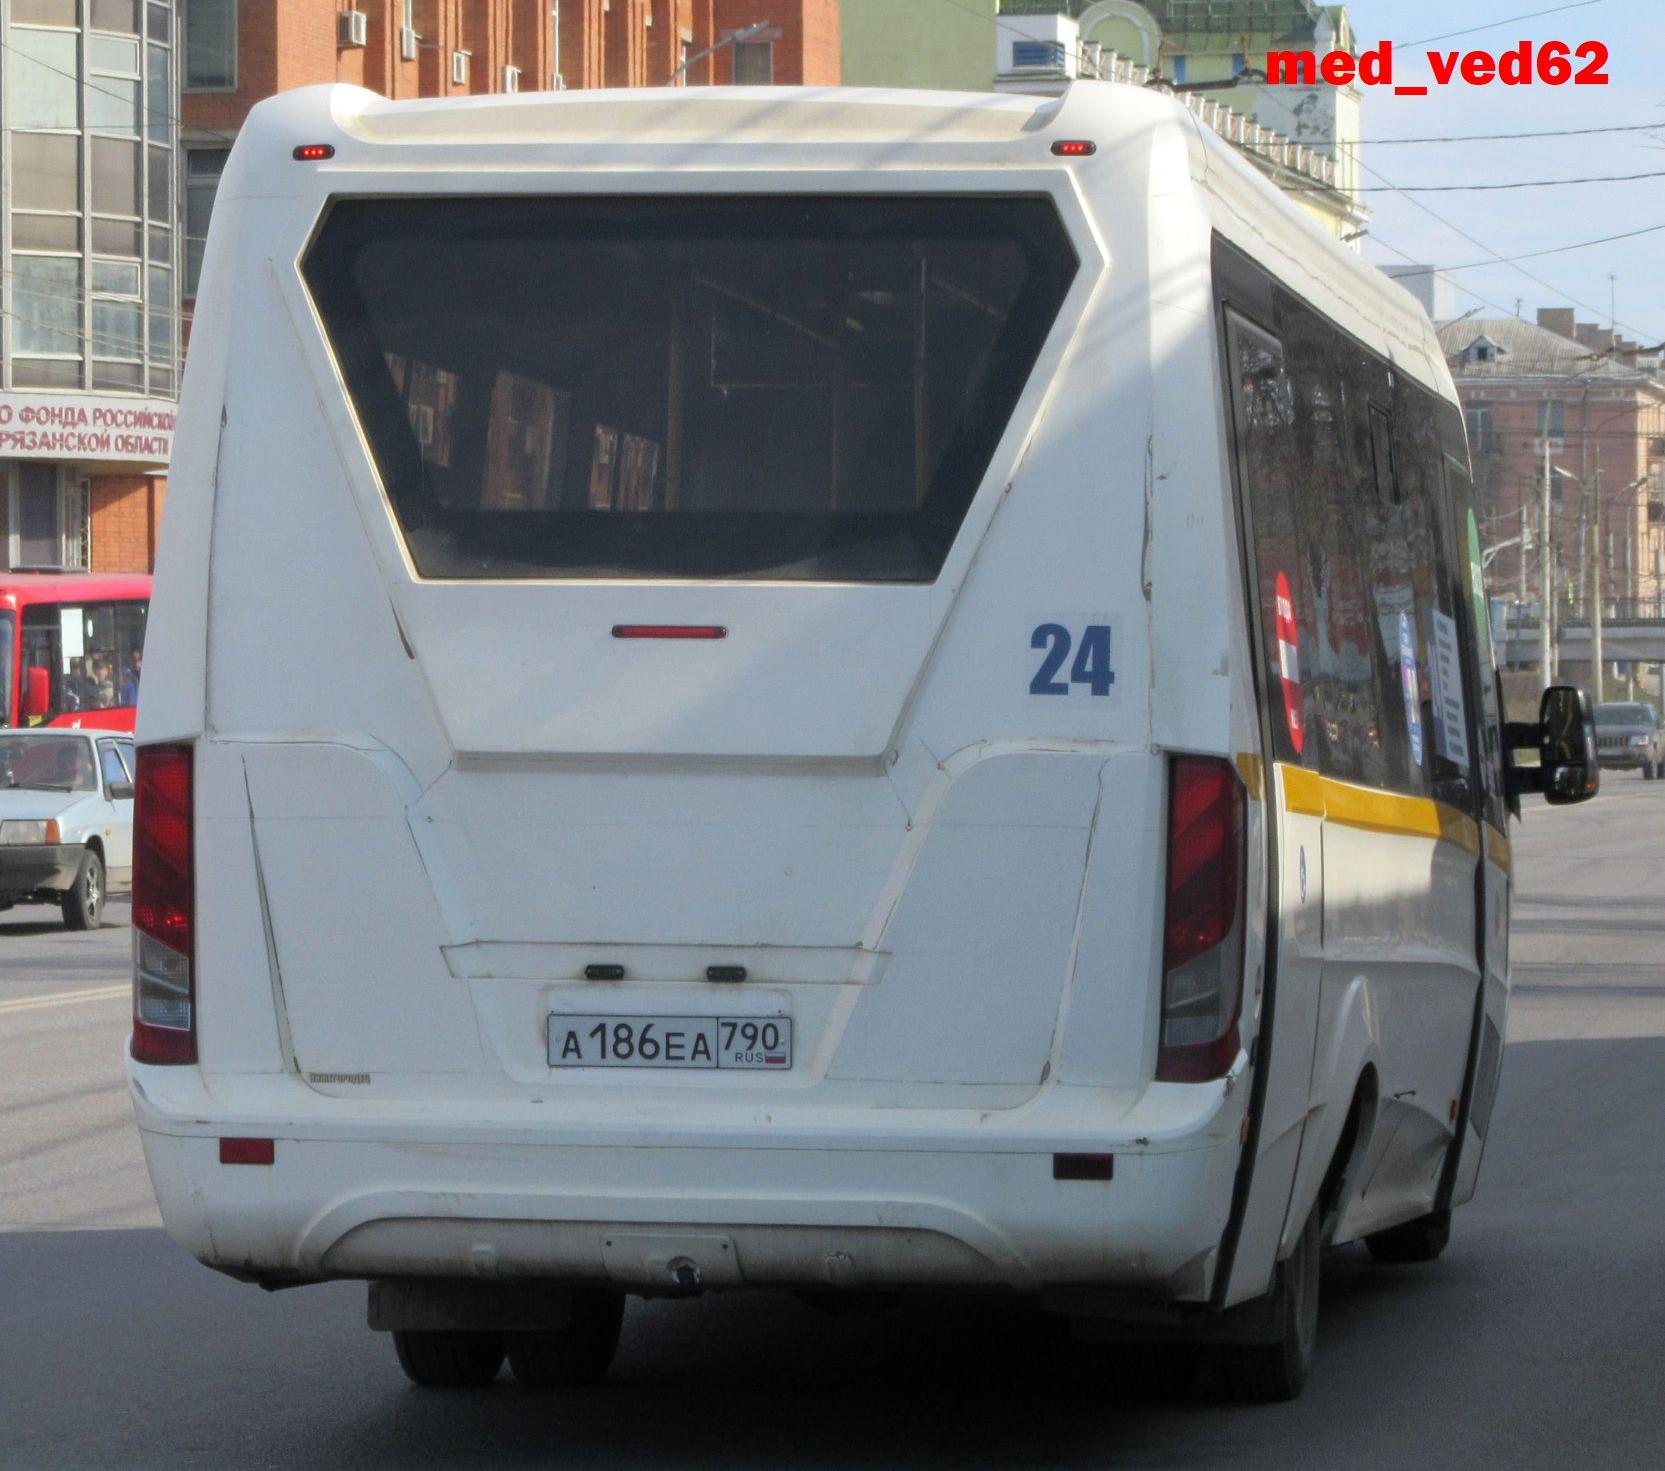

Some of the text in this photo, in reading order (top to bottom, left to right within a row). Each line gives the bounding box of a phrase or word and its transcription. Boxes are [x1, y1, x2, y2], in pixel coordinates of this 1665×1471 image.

[19, 406, 88, 429] ФОНДА
[0, 429, 111, 452] РЯЗАНСКОЙ
[1029, 623, 1115, 697] 24
[721, 1022, 779, 1051] 790
[735, 1051, 763, 1063] RUS
